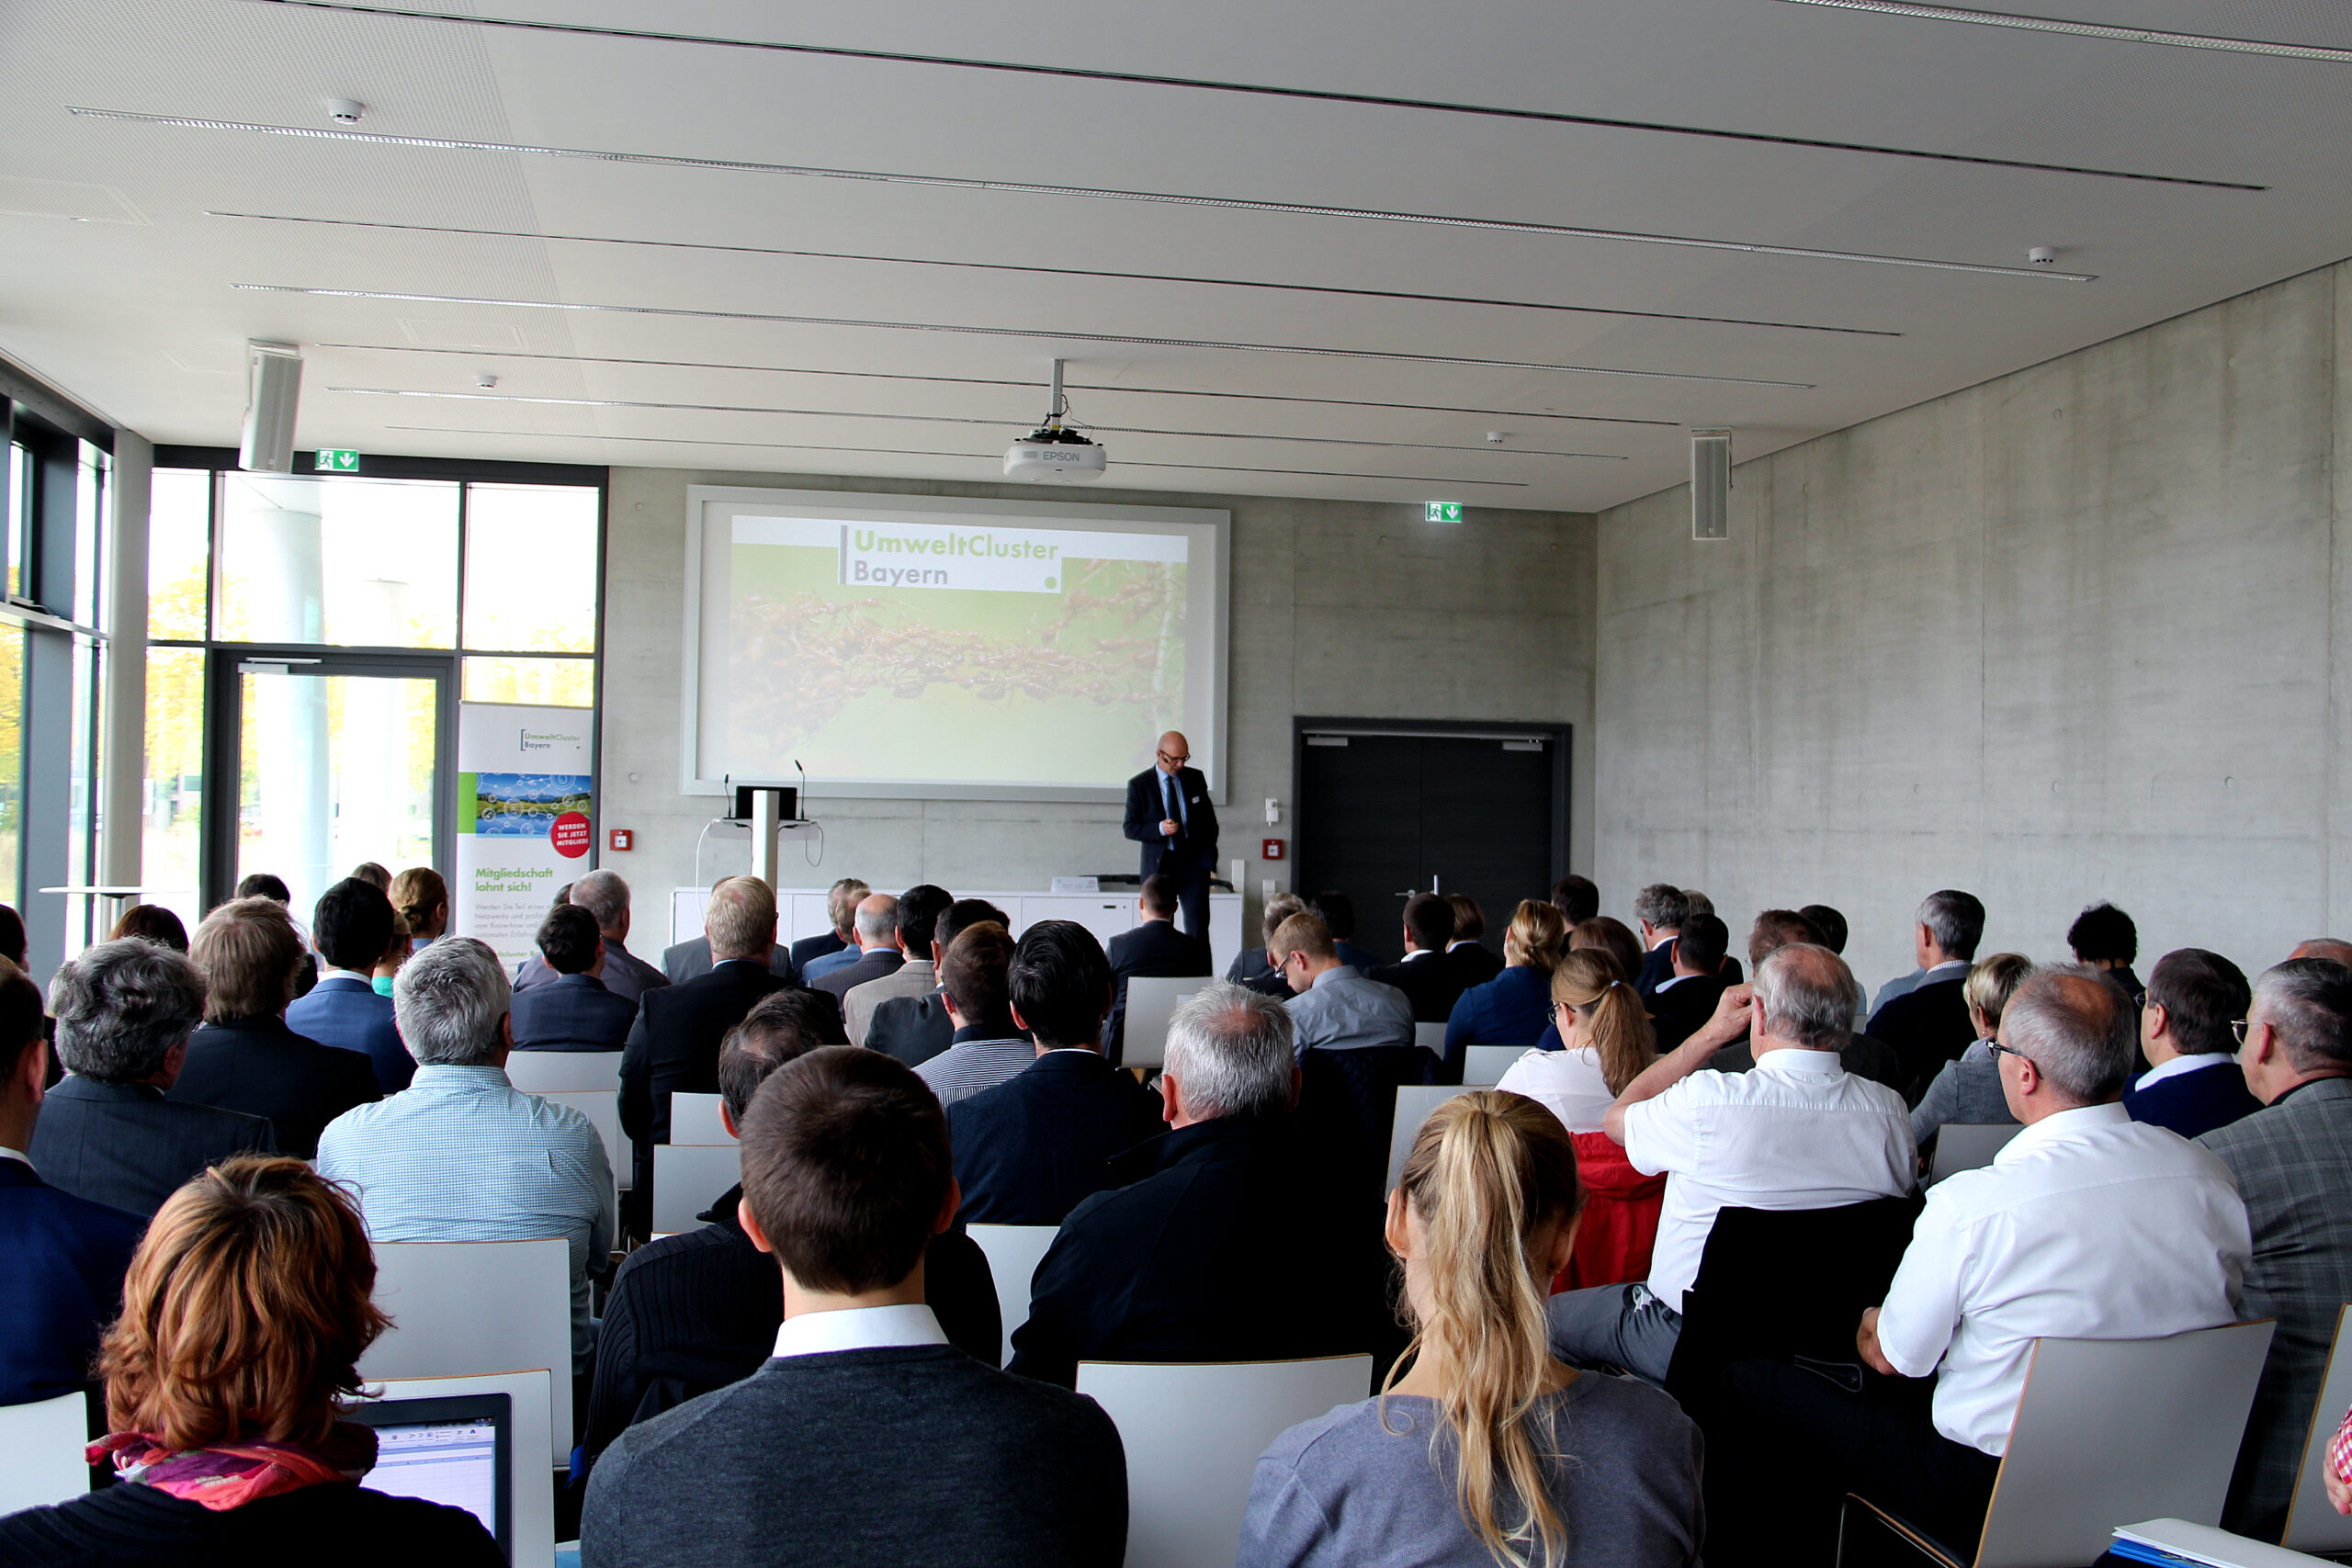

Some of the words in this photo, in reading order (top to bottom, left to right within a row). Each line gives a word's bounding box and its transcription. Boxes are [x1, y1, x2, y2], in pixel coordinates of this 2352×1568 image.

[1043, 450, 1080, 462] EPSON
[854, 529, 1059, 559] UmweltCluster
[854, 559, 948, 587] Bayern
[525, 732, 581, 741] UmweltCluster
[524, 741, 551, 750] Bayern
[475, 867, 553, 880] Mitgliedschaft
[475, 881, 503, 892] lohnt
[507, 881, 532, 892] sich!
